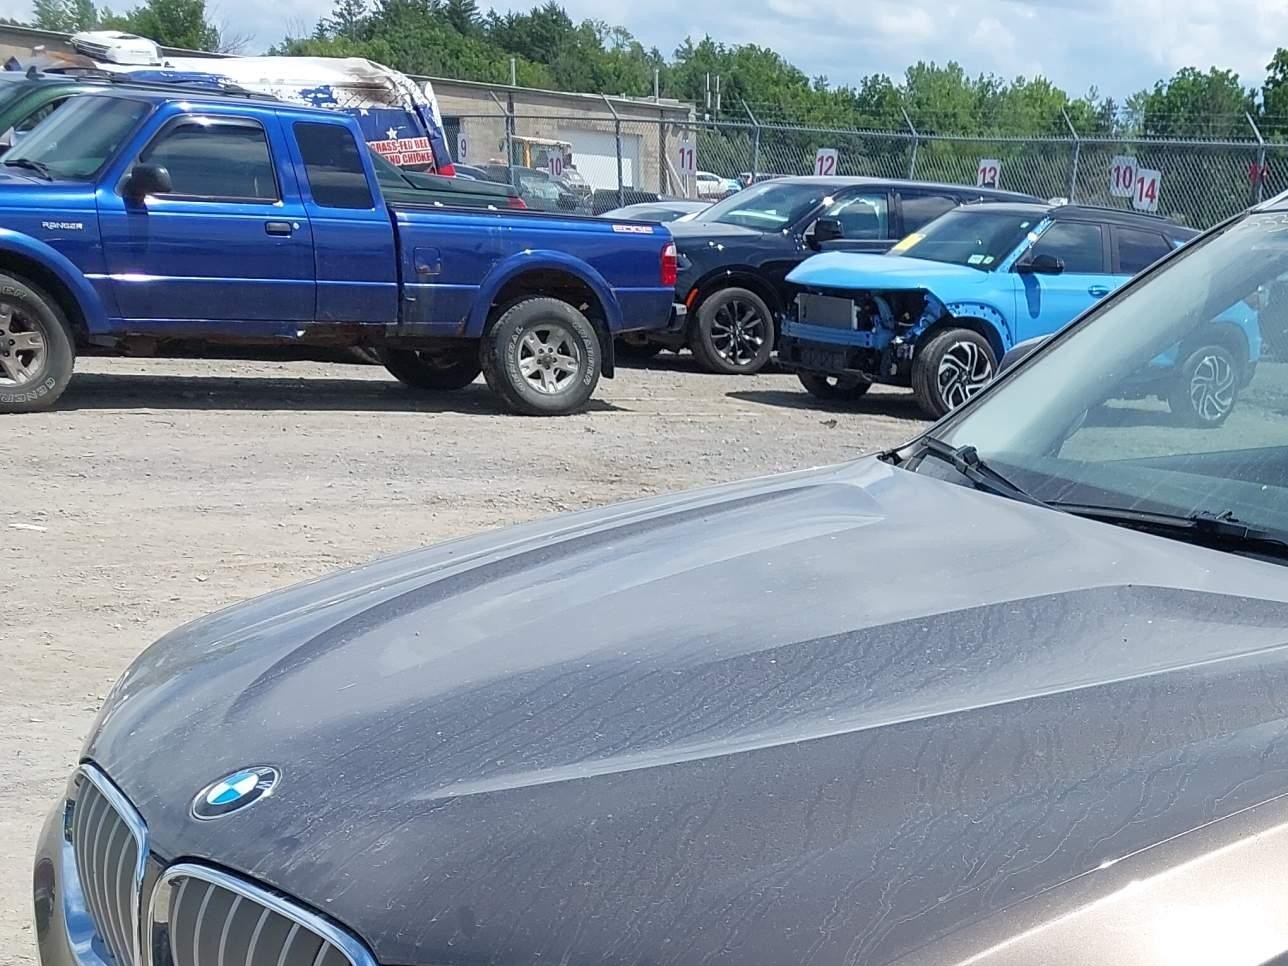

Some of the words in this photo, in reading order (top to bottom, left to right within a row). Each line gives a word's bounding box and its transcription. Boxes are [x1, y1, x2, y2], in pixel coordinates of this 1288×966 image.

[461, 138, 467, 158] 9
[549, 157, 562, 176] 10
[679, 147, 694, 171] 11
[817, 155, 835, 177] 12
[980, 166, 997, 184] 13
[1114, 165, 1133, 190] 10
[1137, 176, 1157, 204] 14
[41, 221, 83, 230] RANGER
